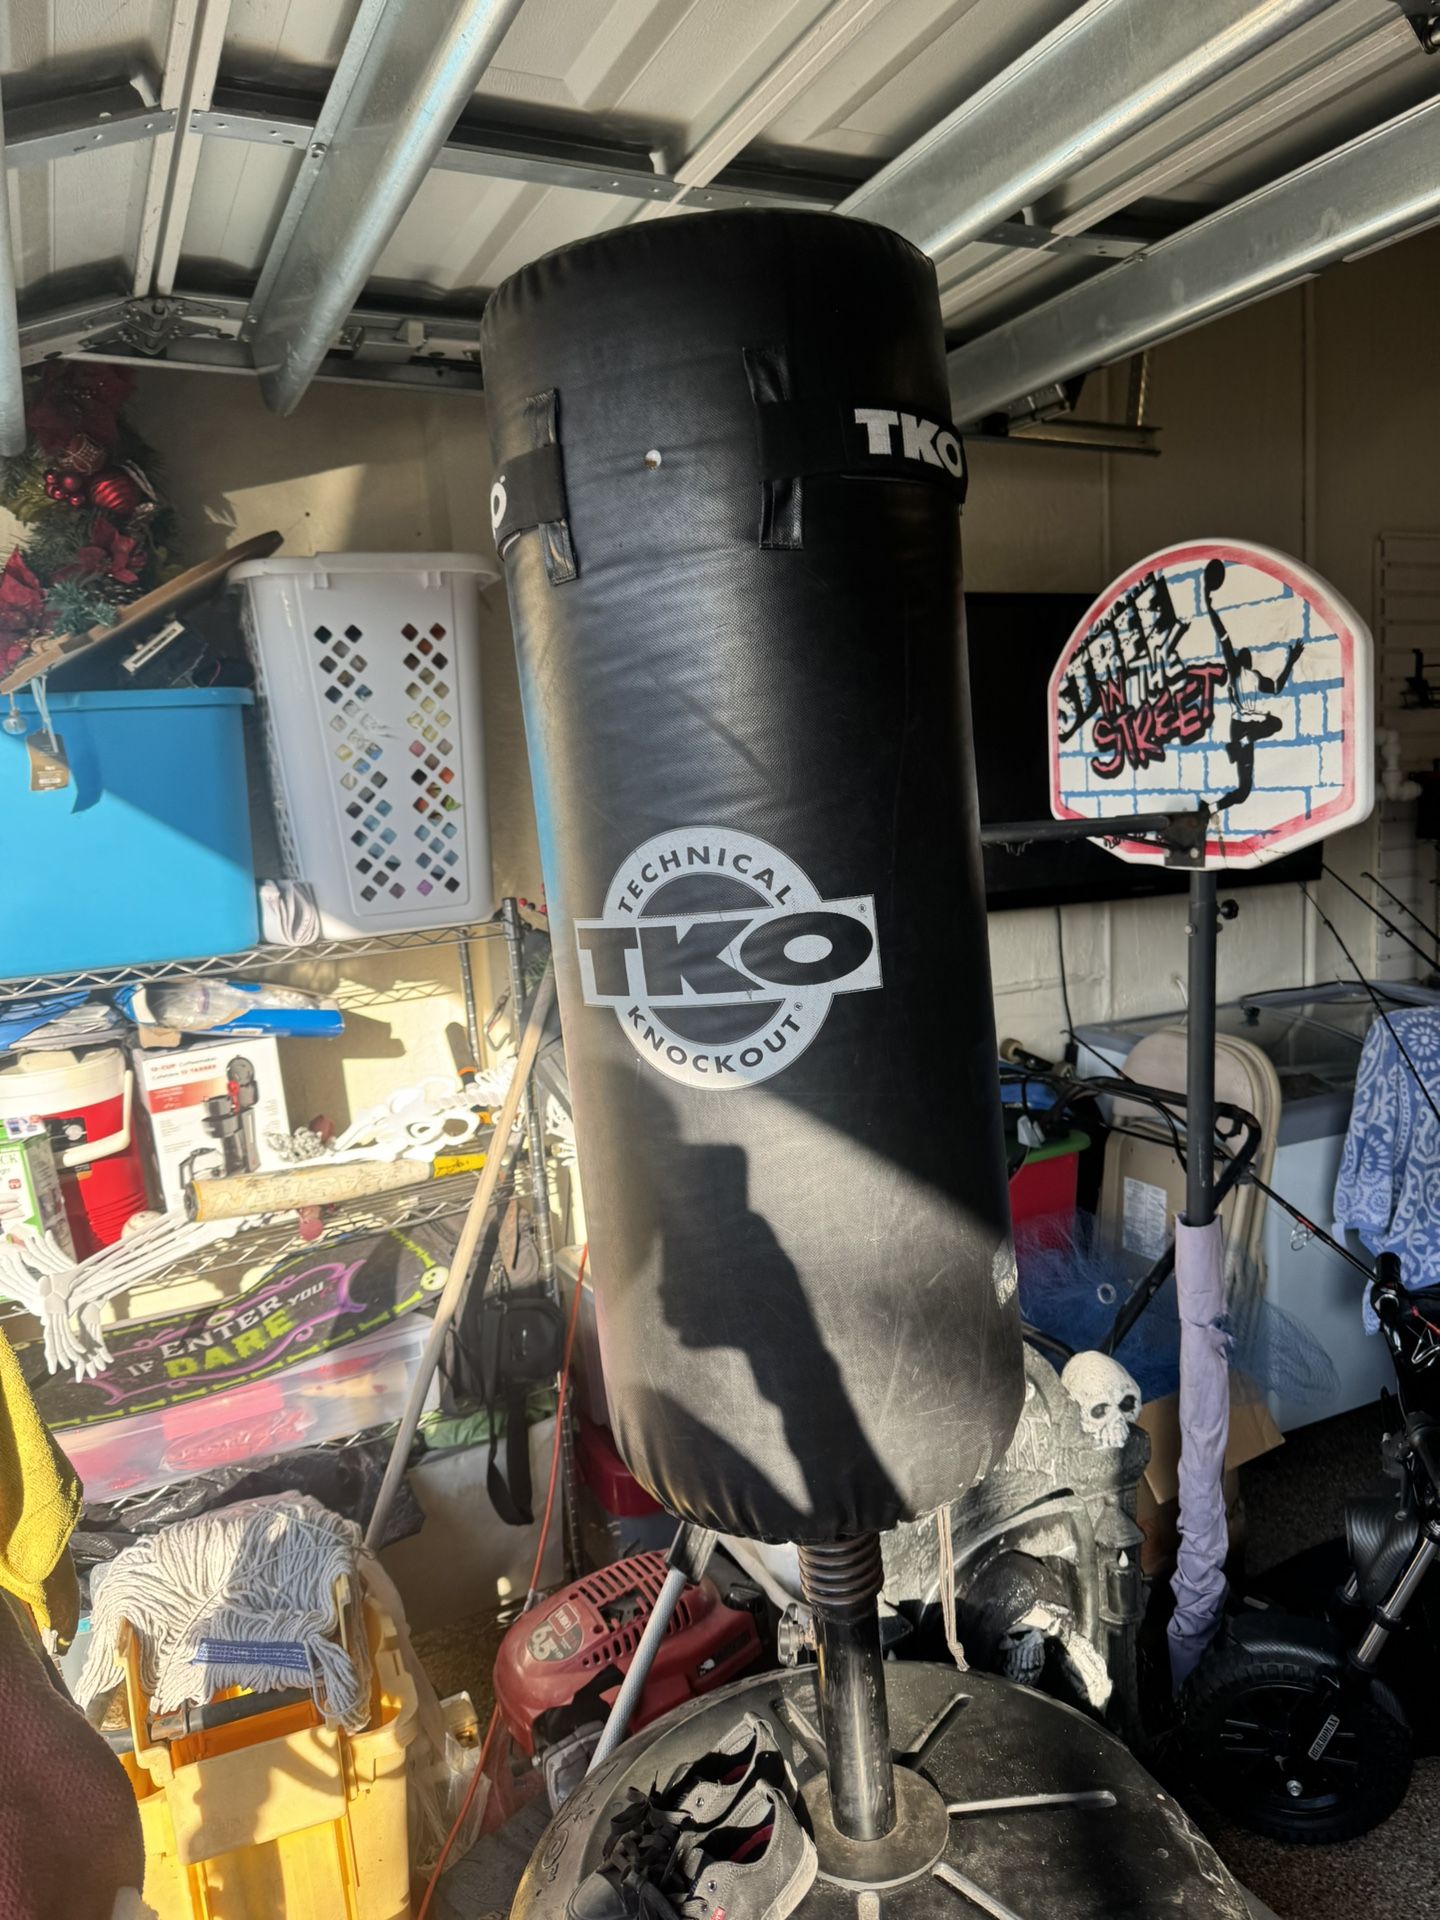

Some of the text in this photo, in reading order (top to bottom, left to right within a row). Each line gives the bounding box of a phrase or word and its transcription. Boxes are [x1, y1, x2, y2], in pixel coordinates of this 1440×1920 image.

[854, 408, 962, 478] TKO
[1091, 667, 1225, 772] STREET
[618, 846, 794, 916] TECHNICAL
[577, 911, 873, 997] TKO
[627, 1005, 803, 1074] KNOCKOUT
[126, 1281, 325, 1377] IF ENTER YOU
[164, 1309, 295, 1378] DARE
